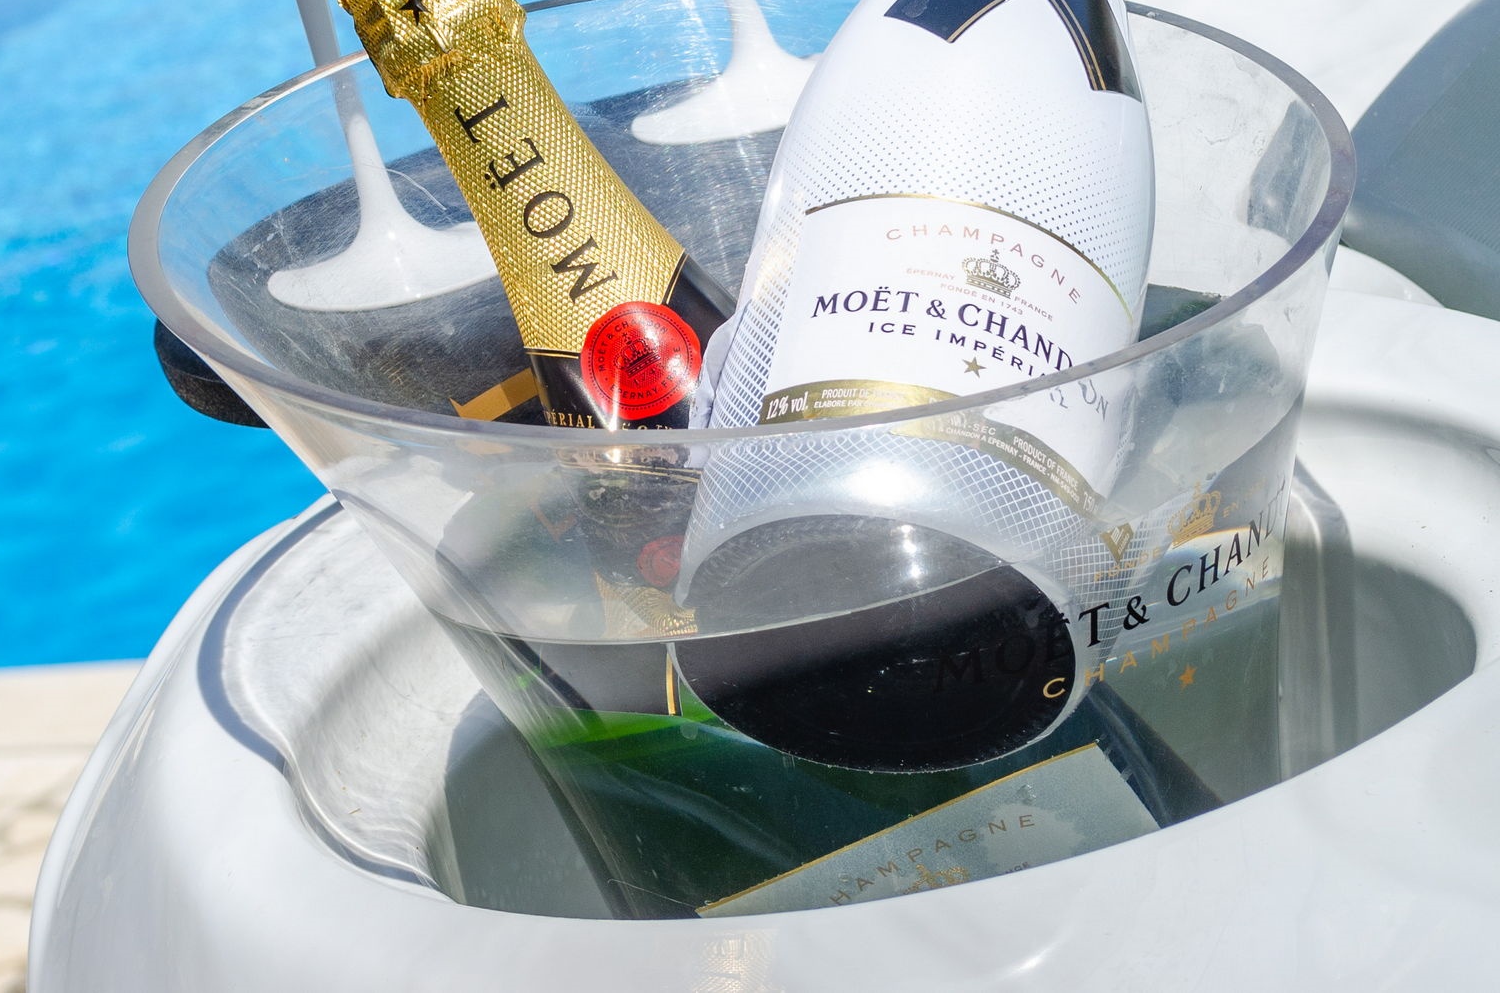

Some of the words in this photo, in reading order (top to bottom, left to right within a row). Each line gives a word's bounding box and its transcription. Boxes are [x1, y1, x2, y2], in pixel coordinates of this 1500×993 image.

[454, 94, 619, 304] MOËT
[885, 223, 1082, 305] CHAMPAGNE
[811, 286, 920, 319] MOËT
[925, 299, 948, 320] &
[981, 293, 996, 303] EN
[1000, 301, 1024, 317] 1743
[1013, 296, 1053, 322] FRANCE
[868, 322, 917, 336] ICE
[765, 395, 789, 420] 12%
[790, 391, 810, 414] vol.
[821, 388, 858, 399] PRODUIT
[945, 426, 981, 440] CHANDON
[987, 437, 1019, 457] EPERNAY
[1022, 456, 1047, 476] FRANCE
[1013, 435, 1047, 464] PRODUCT
[1046, 458, 1057, 471] OF
[1056, 465, 1080, 492] FRANCE
[1122, 595, 1151, 631] &
[1166, 479, 1288, 607] CHAND
[1042, 555, 1270, 699] CHAMPAGNE
[829, 814, 1036, 906] HAMPAGNE
